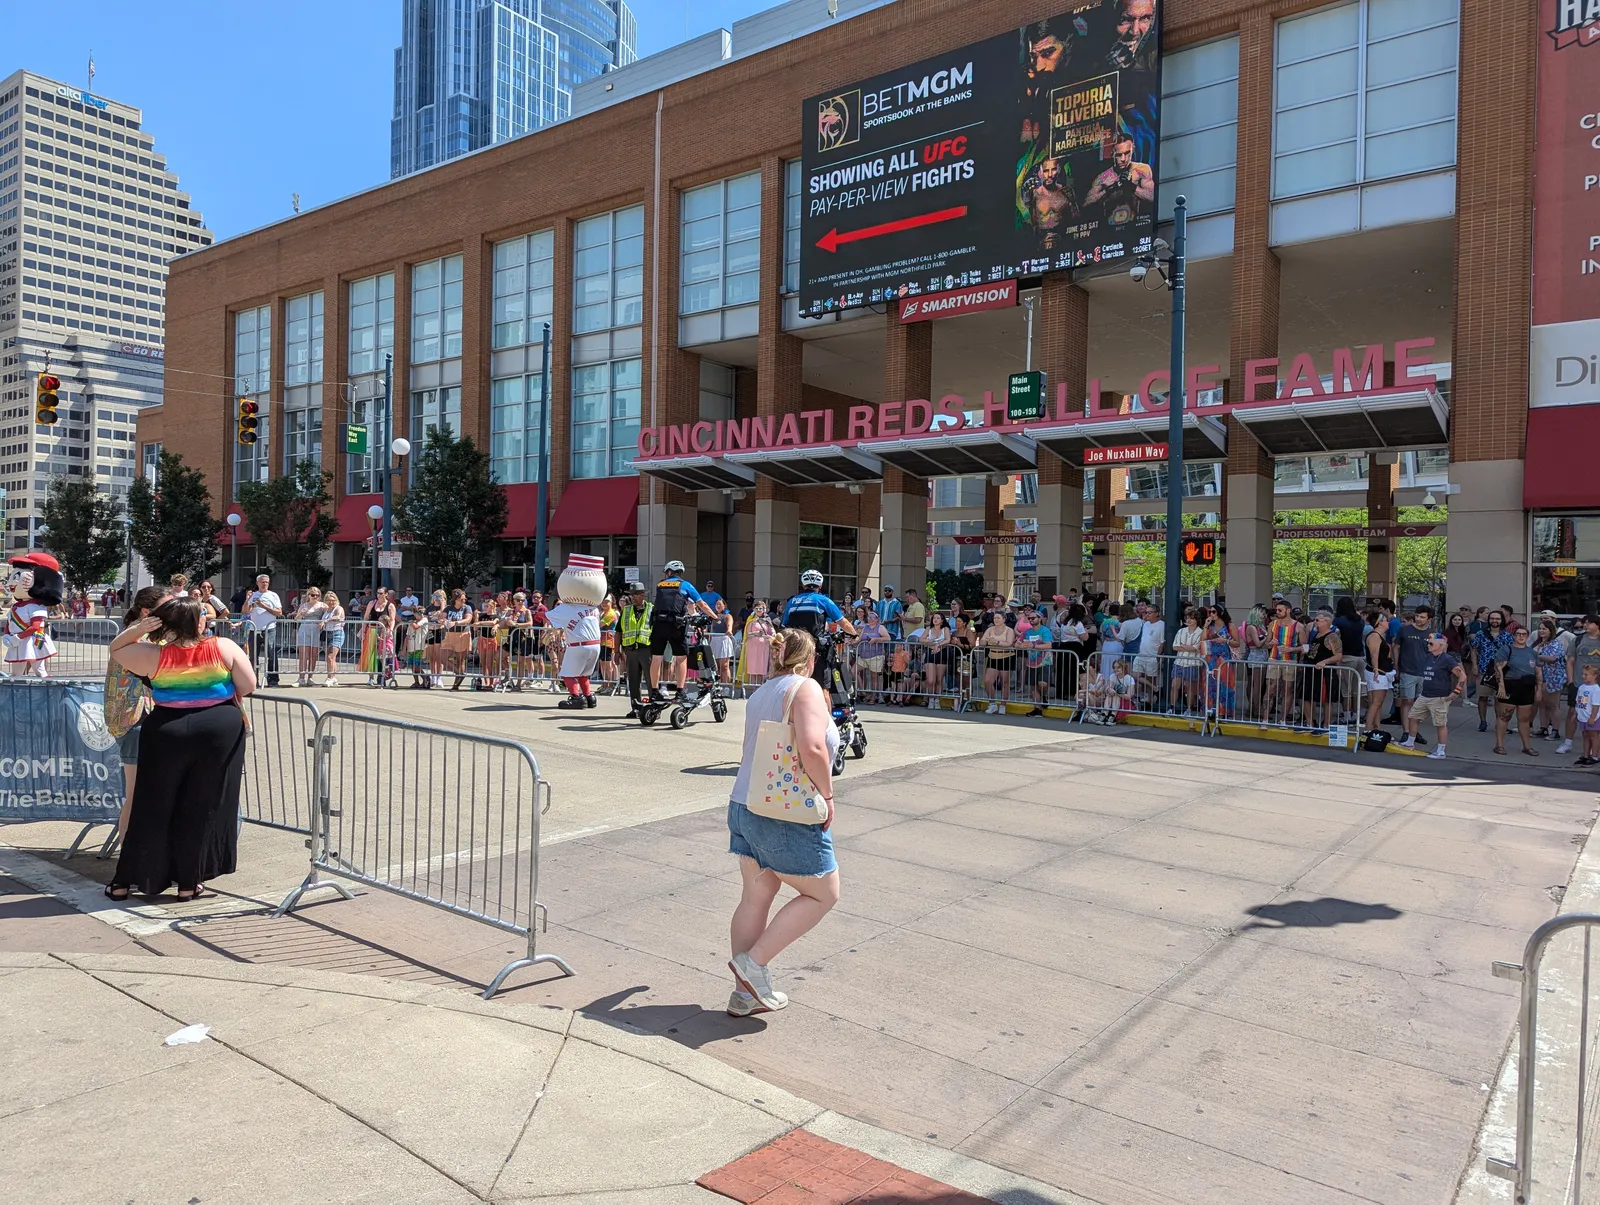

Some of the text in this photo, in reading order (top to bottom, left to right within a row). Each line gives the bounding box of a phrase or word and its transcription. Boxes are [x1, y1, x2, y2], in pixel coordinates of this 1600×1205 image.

[57, 86, 109, 111] altafiber
[863, 61, 973, 117] BETMGM
[1056, 84, 1113, 113] TOPURIA
[863, 90, 972, 129] SPORTSBOOK AT THE BANKS
[1055, 99, 1113, 128] OLIVEIRA
[809, 135, 968, 194] SHOWING ALL UFC
[810, 159, 975, 218] PAY-PER-VIEW FIGHTS
[1066, 225, 1079, 234] JUNE
[1088, 220, 1099, 229] SAT
[828, 271, 848, 280] PRESENT
[864, 263, 892, 273] GAMBLING
[892, 256, 919, 267] PROBLEM?
[920, 254, 932, 262] CALL
[840, 275, 870, 286] PARTNERSHIP
[871, 272, 885, 280] WITH
[900, 263, 932, 274] NORTHFIELD
[921, 287, 1009, 314] SMARTVISION
[133, 347, 148, 356] GO
[1011, 385, 1031, 394] Street
[1012, 376, 1028, 385] Main
[637, 407, 834, 457] CINCINNATI
[848, 393, 967, 440] REDS
[983, 378, 1117, 427] HLL
[1244, 336, 1437, 402] FAME
[1011, 407, 1037, 417] 100-159
[1087, 446, 1164, 462] Joe Nuxhall Way
[1202, 542, 1213, 560] 10
[0, 757, 109, 781] COME TO
